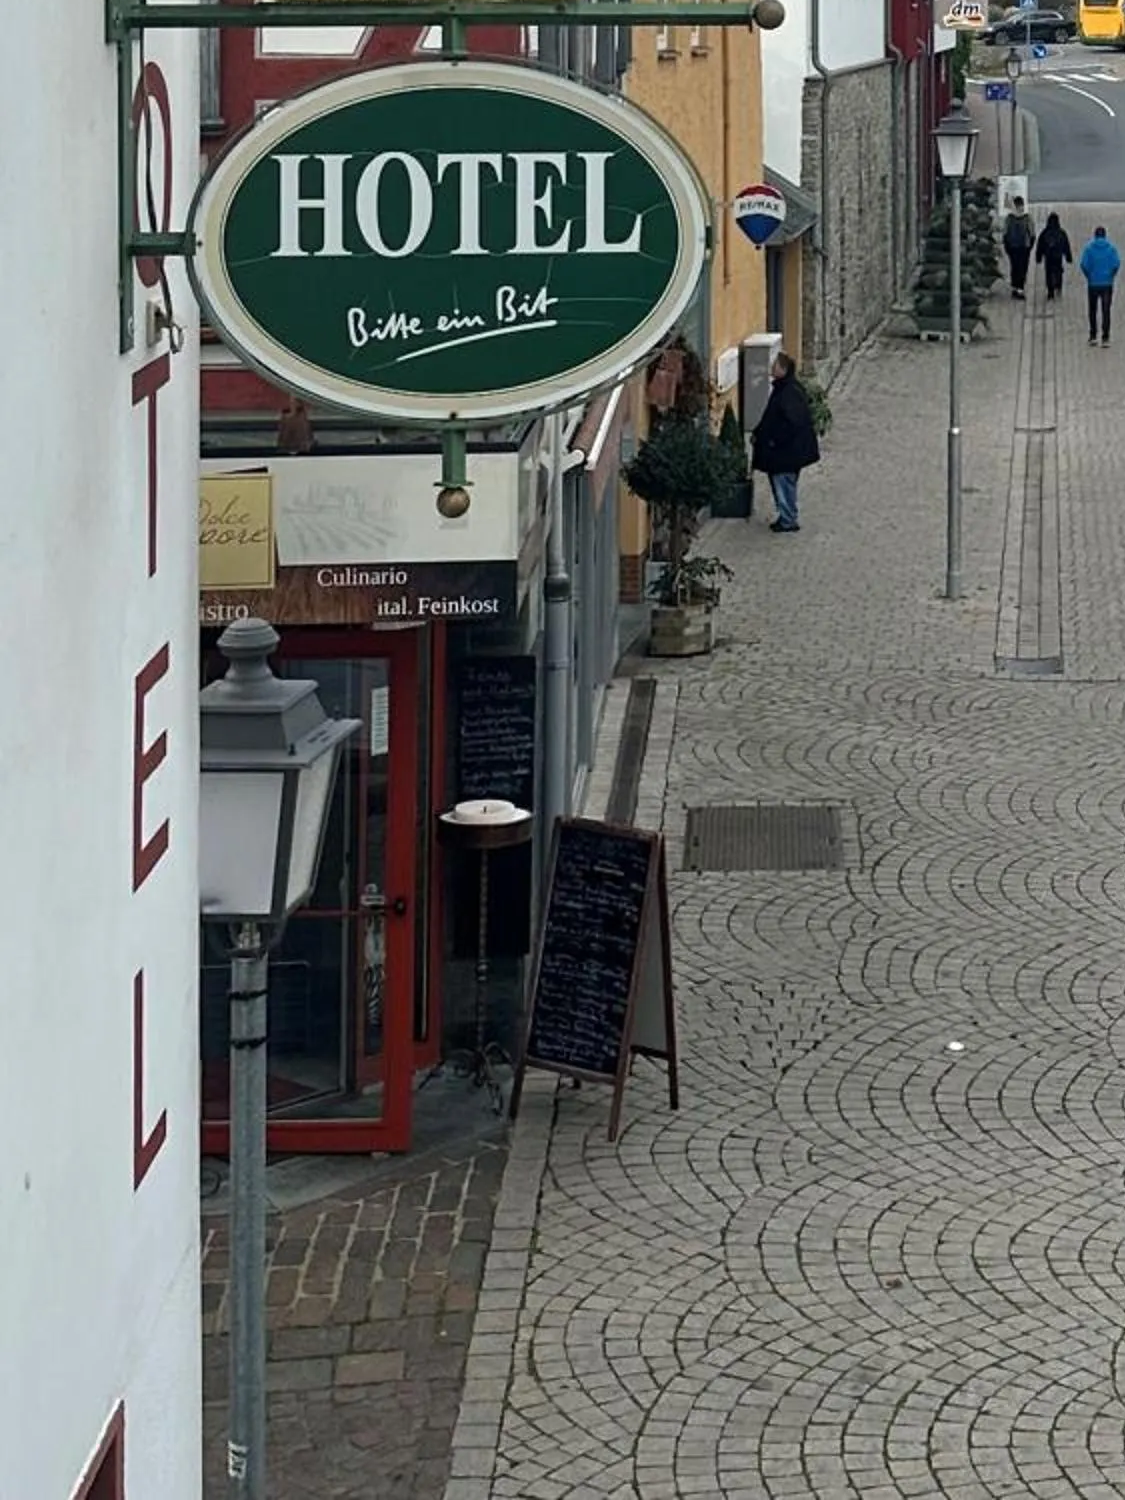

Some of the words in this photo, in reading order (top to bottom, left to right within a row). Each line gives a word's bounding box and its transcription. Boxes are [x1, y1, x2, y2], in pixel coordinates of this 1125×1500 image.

[951, 0, 979, 16] dm
[270, 150, 643, 258] HOTEL
[347, 306, 424, 347] Bitte
[437, 307, 485, 332] ein
[495, 285, 559, 323] Bit
[316, 567, 408, 588] Culinario
[376, 596, 413, 617] ital.
[417, 595, 500, 616] Feinkost
